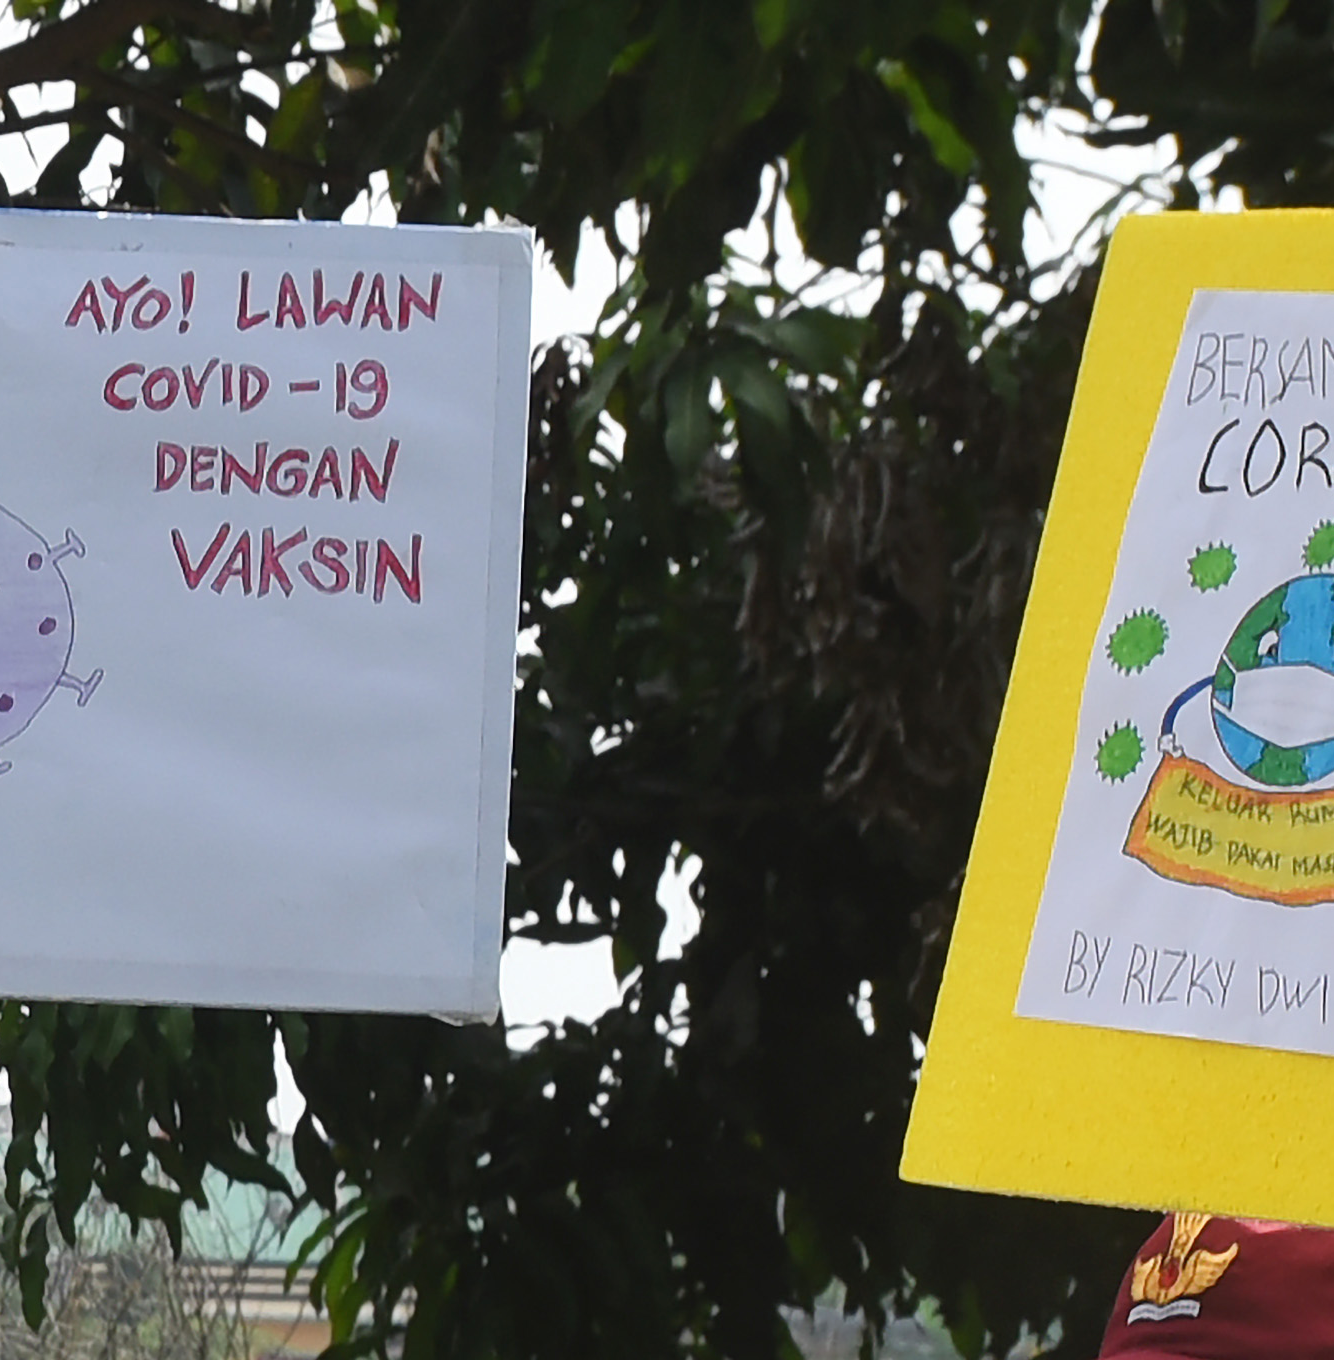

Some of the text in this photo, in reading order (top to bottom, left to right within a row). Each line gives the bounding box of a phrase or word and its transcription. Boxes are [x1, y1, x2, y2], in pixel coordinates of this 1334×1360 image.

[65, 268, 442, 333] AYO! LAWAN
[154, 437, 400, 502] DENGAN
[171, 522, 422, 604] VAKSIN
[1178, 773, 1271, 825] KELUAR
[1145, 811, 1214, 855] WAJIB
[1227, 840, 1282, 871] PAKAI
[1064, 929, 1111, 999] BY
[1122, 943, 1236, 1010] RIZKY
[1258, 966, 1329, 1024] DWI
